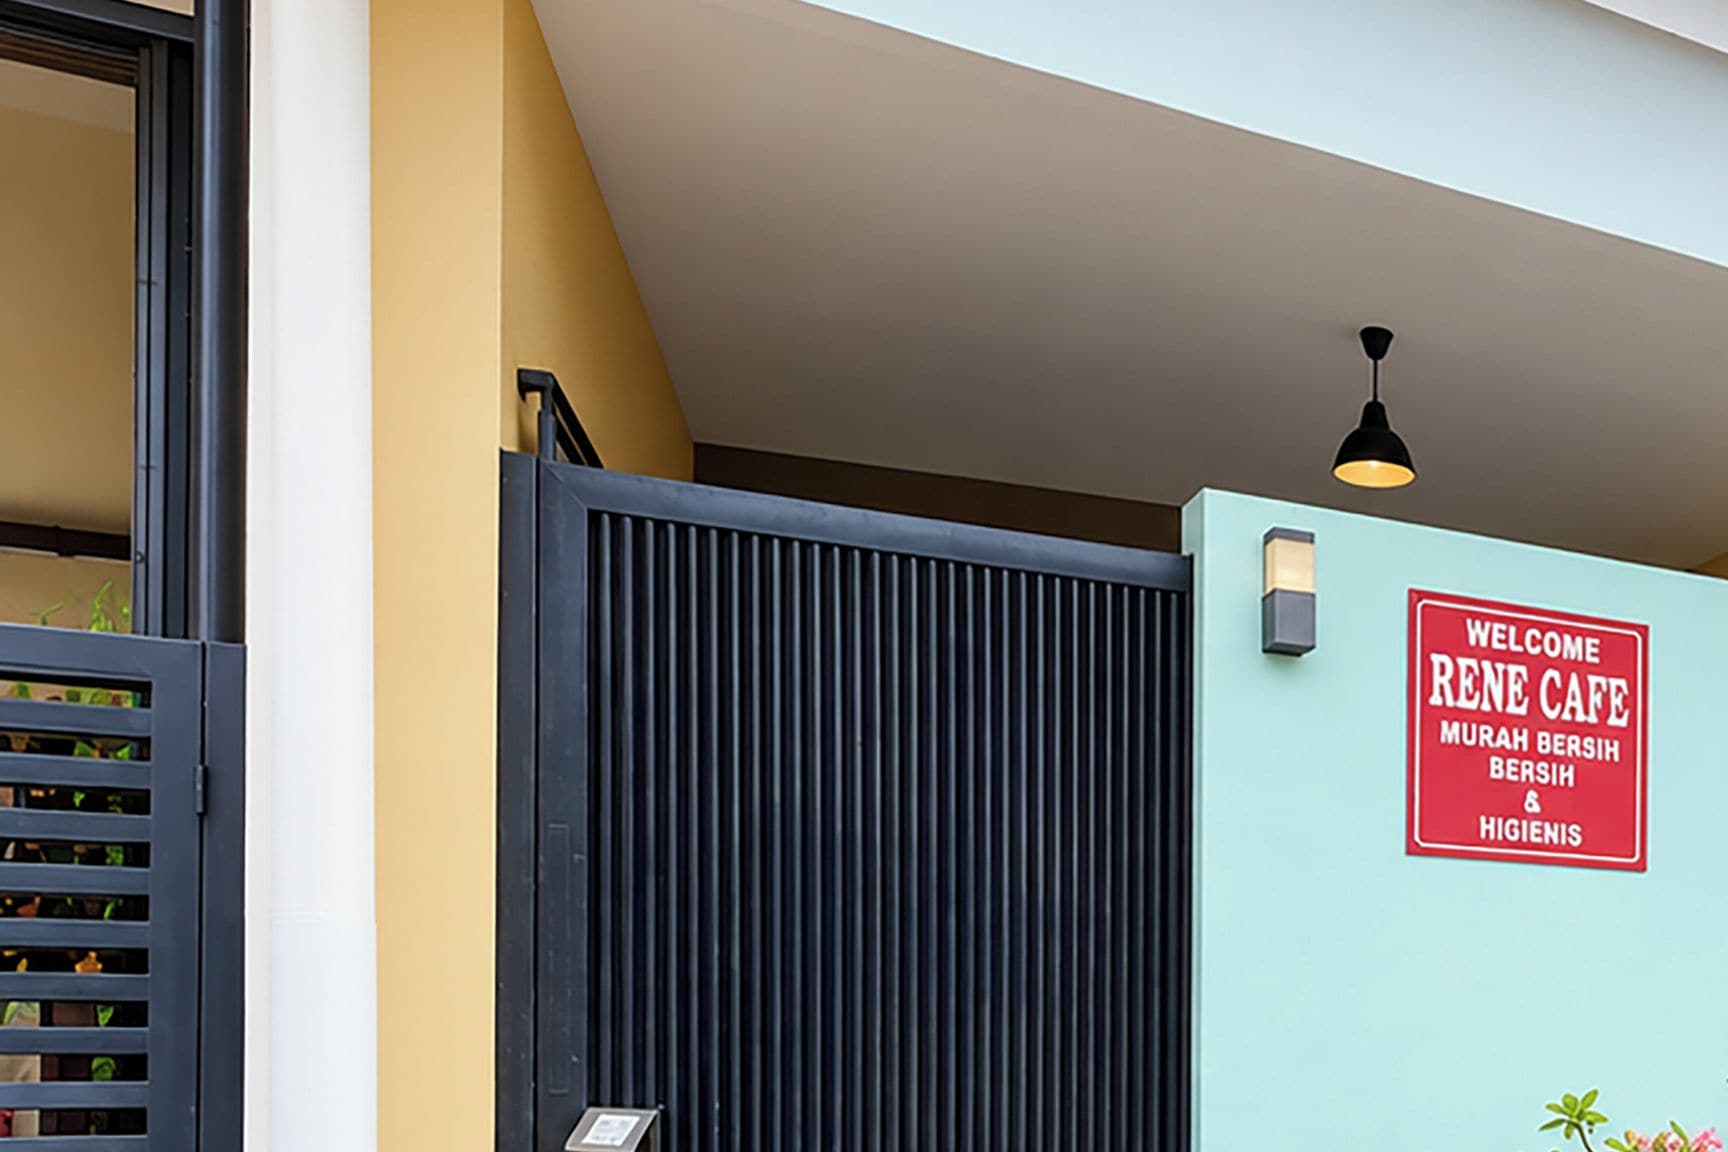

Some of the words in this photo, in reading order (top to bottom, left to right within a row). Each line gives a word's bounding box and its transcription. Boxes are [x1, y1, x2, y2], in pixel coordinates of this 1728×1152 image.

[1467, 619, 1600, 663] WELCOME
[1429, 653, 1528, 715] RENE
[1540, 668, 1629, 727] CAFE
[1441, 721, 1528, 751] MURAH
[1537, 732, 1619, 761] BERSIH
[1490, 756, 1574, 787] BERSIH
[1524, 790, 1541, 813] &
[1480, 816, 1582, 846] HIGIENIS
